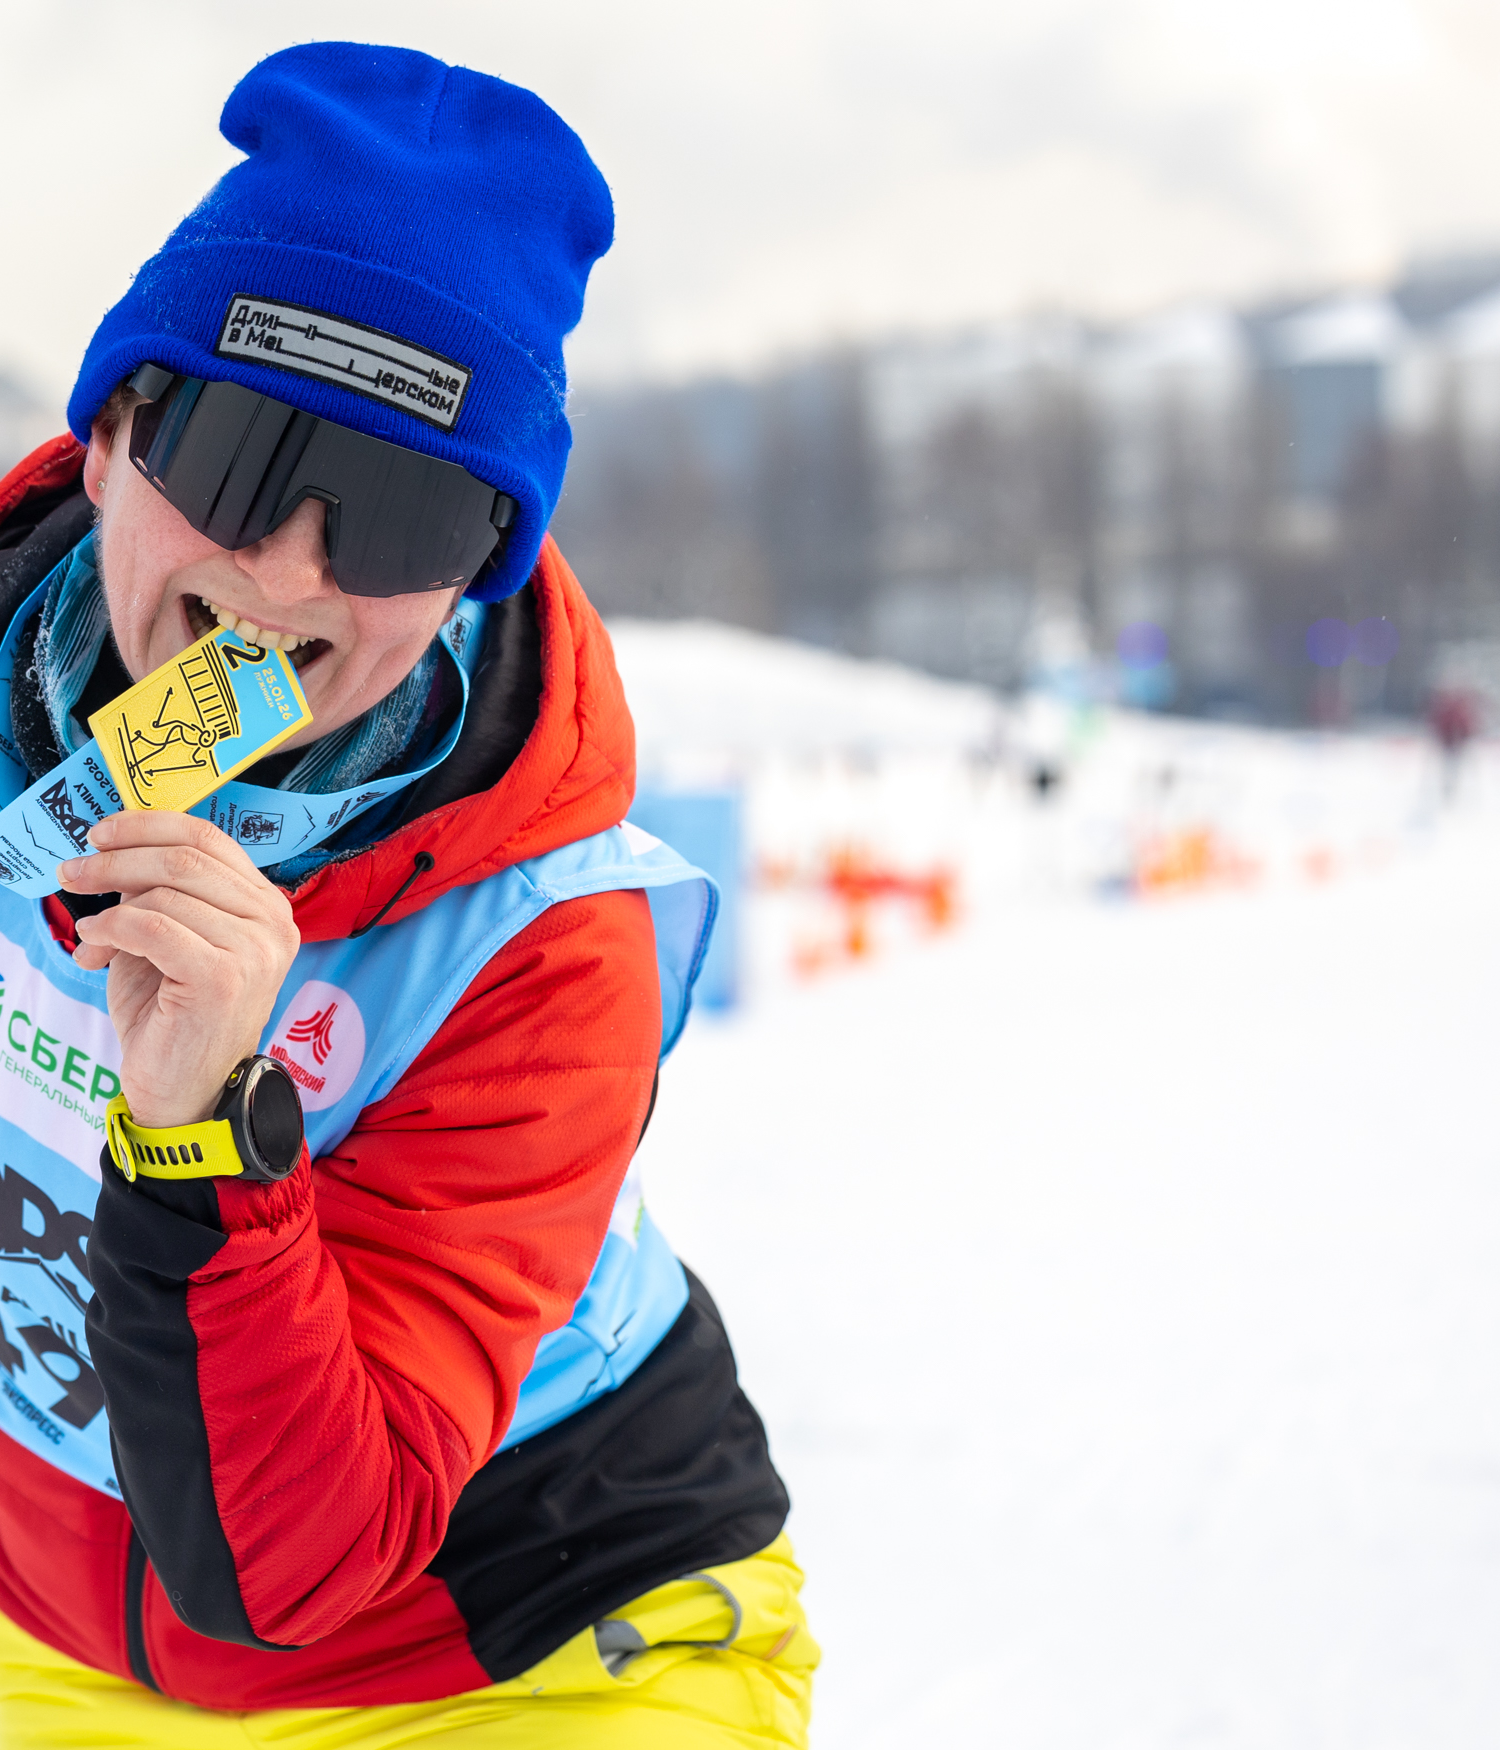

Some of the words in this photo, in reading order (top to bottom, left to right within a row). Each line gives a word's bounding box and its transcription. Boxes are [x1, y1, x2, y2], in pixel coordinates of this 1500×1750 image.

[253, 671, 275, 709] ЛУЖНИКИ
[262, 667, 294, 720] 25.01.26
[73, 783, 108, 821] FAMILY
[83, 757, 125, 812] 5.01.2026
[39, 777, 89, 853] TOPSKI
[209, 795, 218, 822] города
[227, 802, 237, 838] Департам
[0, 835, 23, 858] Москвы
[6, 850, 28, 870] спорта
[69, 839, 82, 855] TEAM
[23, 856, 45, 877] города
[7, 1009, 122, 1103] СБЕР
[0, 1049, 106, 1135] ГЕНЕРАЛЬНЫЙ
